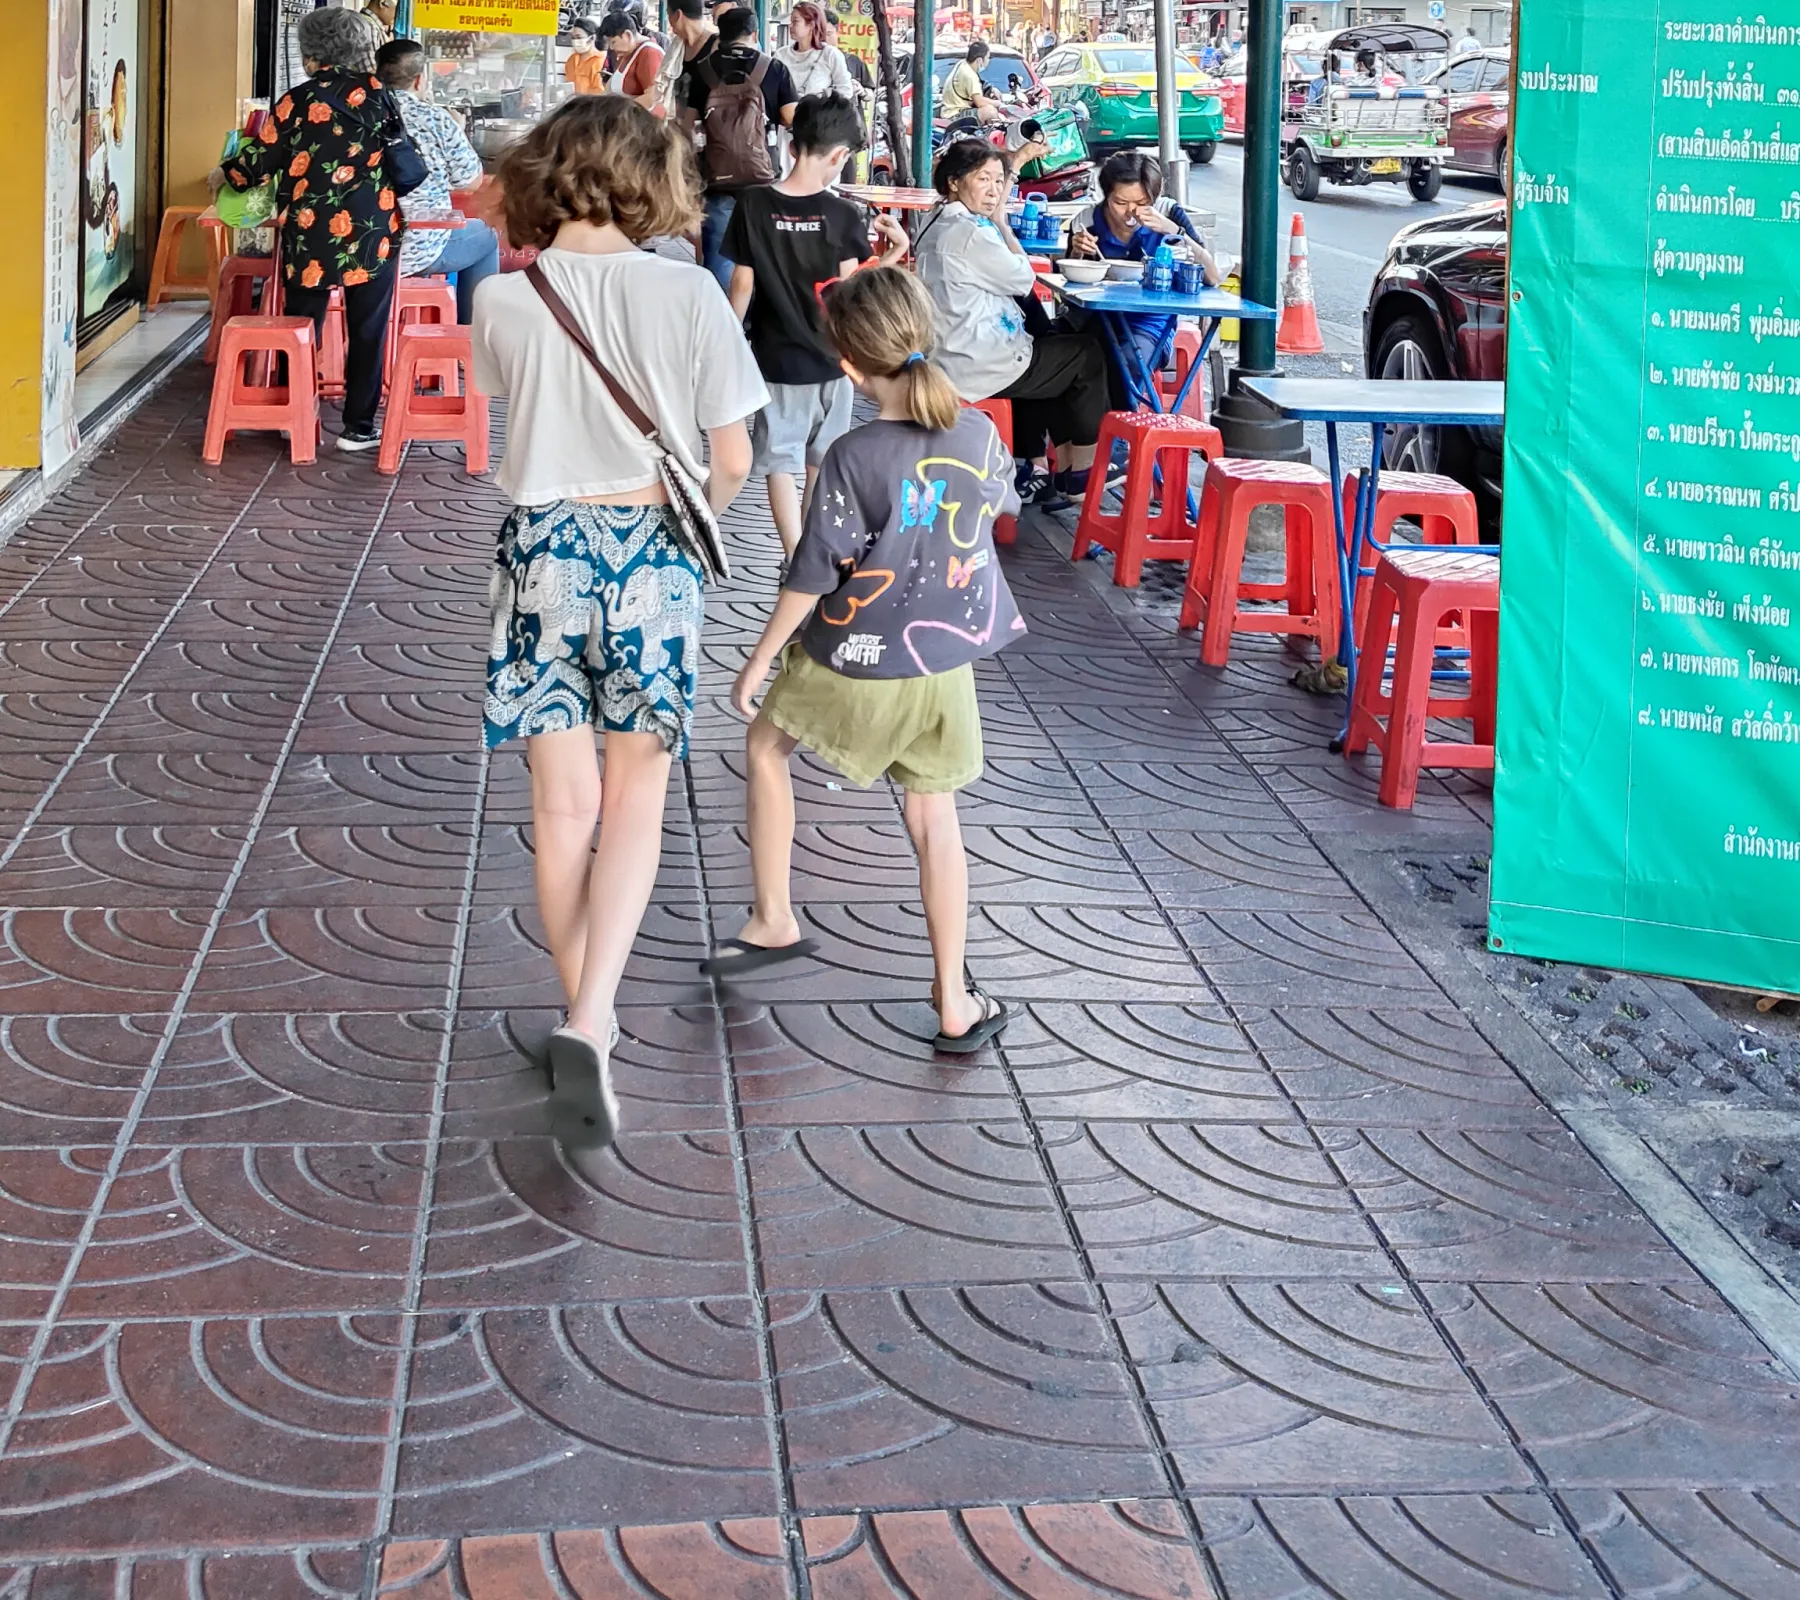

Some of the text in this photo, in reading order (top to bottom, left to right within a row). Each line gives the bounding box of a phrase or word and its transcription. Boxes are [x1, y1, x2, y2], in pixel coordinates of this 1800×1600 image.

[837, 20, 876, 37] true
[1520, 61, 1599, 94] งบประมาณ
[1661, 61, 1765, 109] ปรับปรุงทั้งสิ้น
[1514, 171, 1569, 210] ผู้รับจ้าง
[1655, 183, 1756, 218] ดำเนินการโดย
[795, 221, 822, 232] PIECE
[1652, 238, 1744, 281] ผู้ควบคุมงาน
[1668, 302, 1741, 333] นายมนตรี
[1671, 359, 1741, 391] นายชัชชัย
[1668, 416, 1736, 448] นายปรีชา
[1659, 585, 1725, 619] นายธงชัย
[1732, 593, 1791, 628] เพ็งน้อย
[1661, 651, 1740, 679] นายพงศกร
[1659, 704, 1724, 735] นายพนัส
